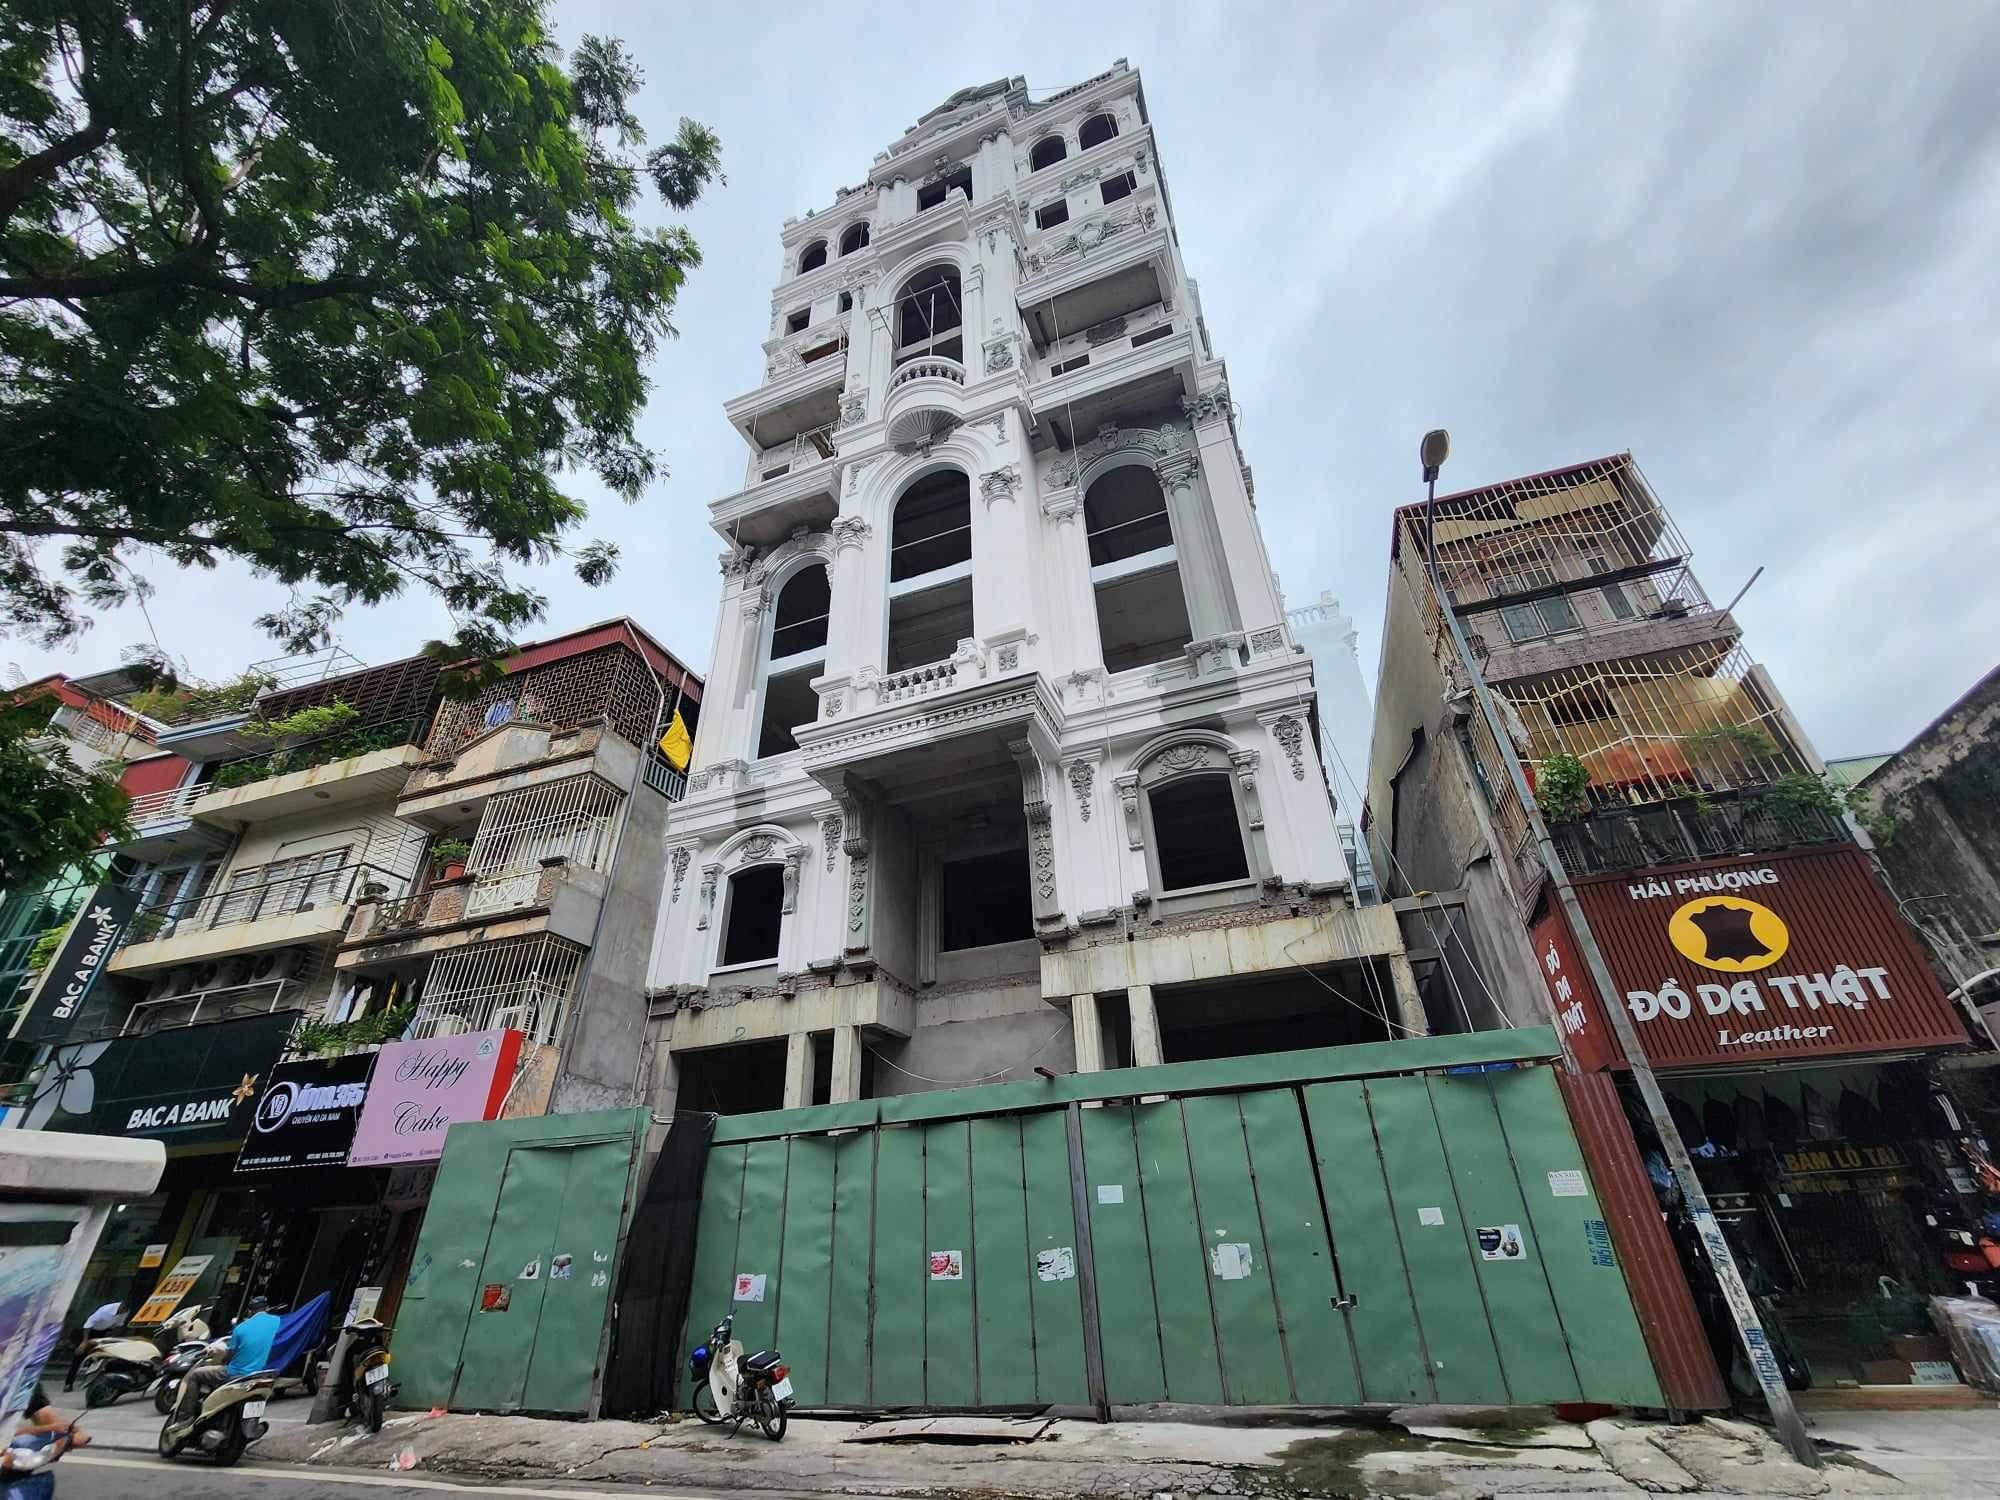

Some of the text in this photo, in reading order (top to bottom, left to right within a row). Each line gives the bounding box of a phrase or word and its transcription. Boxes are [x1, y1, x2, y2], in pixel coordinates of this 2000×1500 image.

[1628, 868, 1779, 899] HẢI PHƯỢNG
[52, 921, 118, 1019] BAC A BANK
[1555, 975, 1572, 1002] DA
[1627, 964, 1892, 1022] ĐỒ DA THẬT
[1561, 1001, 1587, 1035] THẬT
[1718, 1024, 1833, 1047] Leather
[394, 1049, 471, 1090] Happy
[127, 1097, 236, 1129] BAC A BANK
[393, 1101, 449, 1135] Cake
